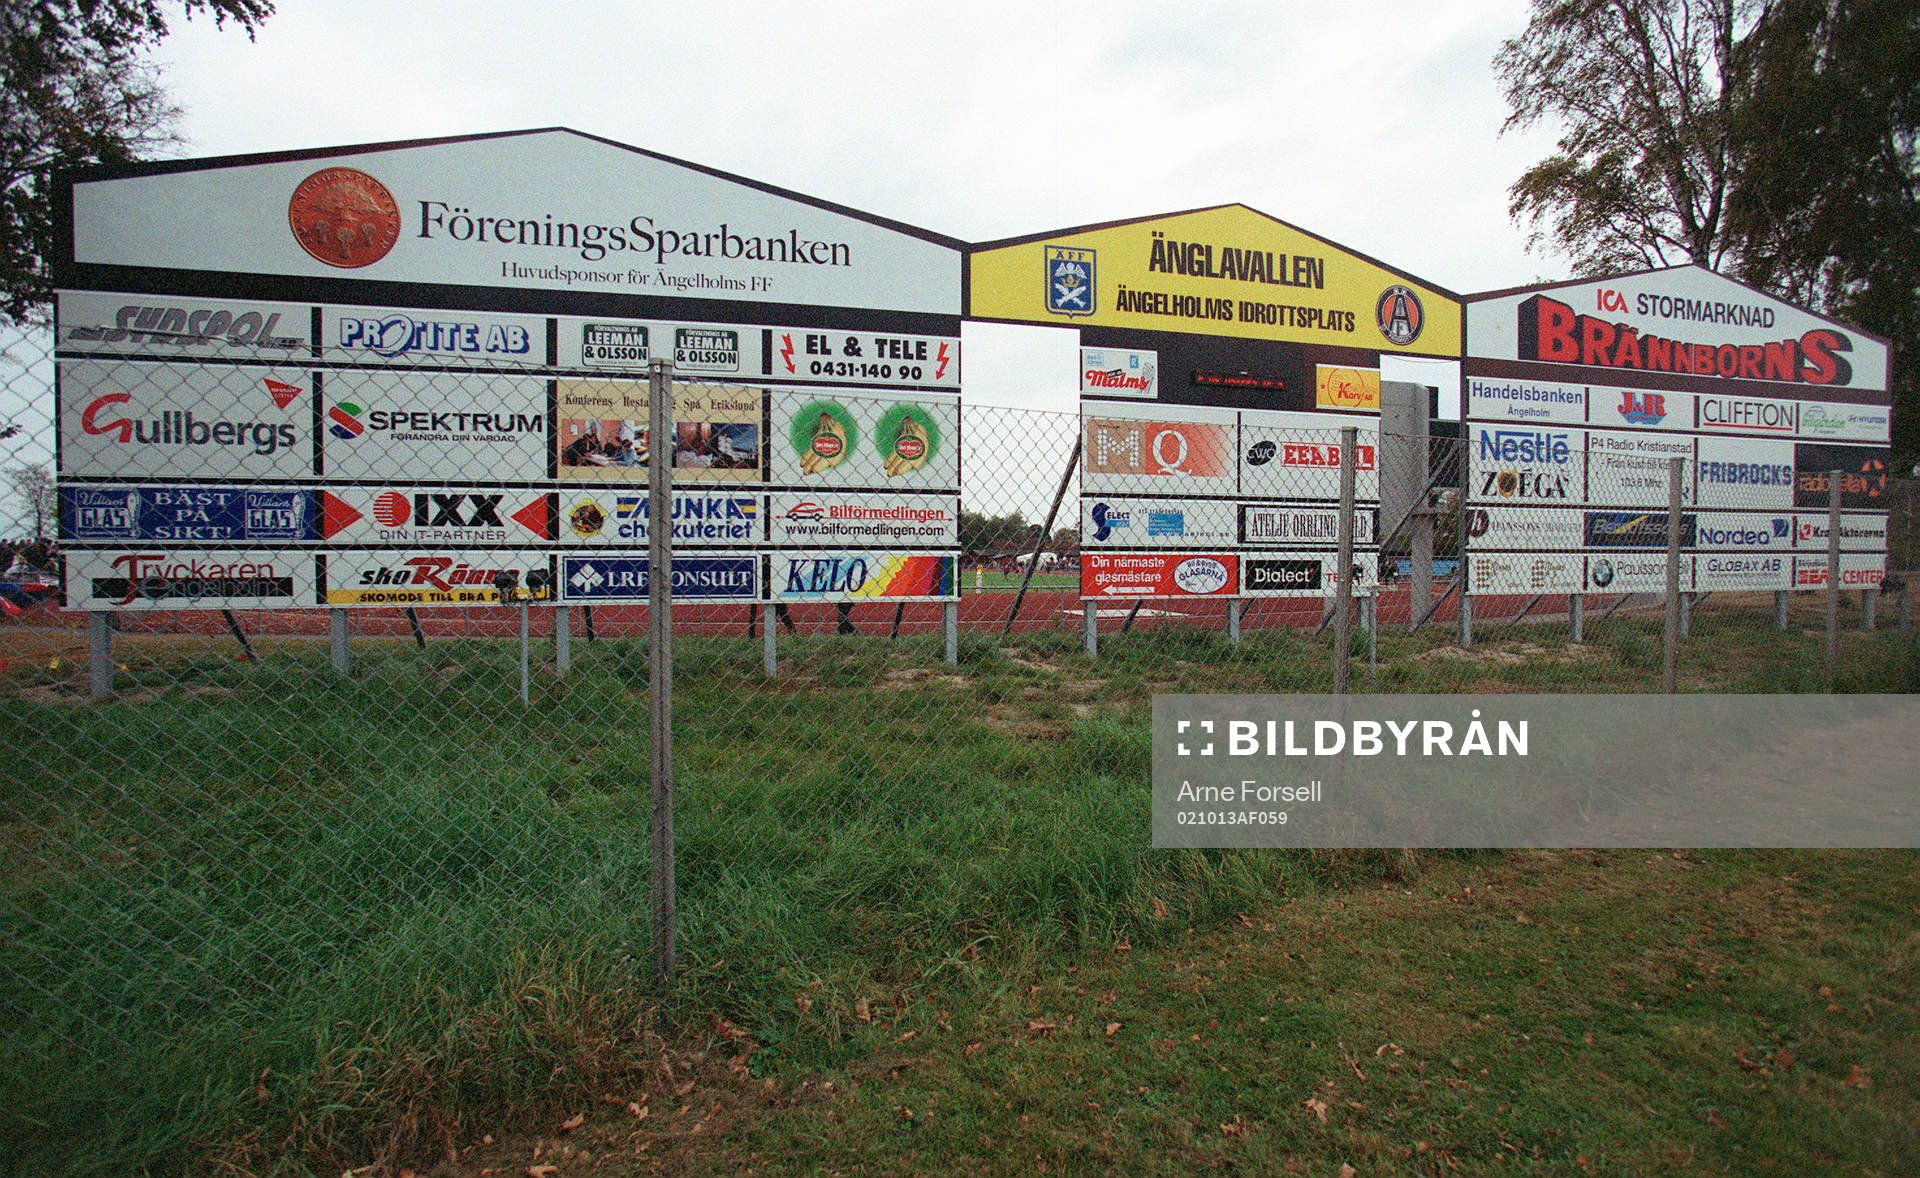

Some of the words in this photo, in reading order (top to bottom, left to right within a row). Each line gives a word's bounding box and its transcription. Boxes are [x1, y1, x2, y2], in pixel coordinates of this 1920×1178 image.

[417, 200, 852, 266] FöreningsSparbanken
[1056, 248, 1085, 261] ÄFF
[1149, 230, 1324, 290] ÄNGLAVALLEN
[502, 261, 624, 285] Huvudsponsor
[627, 268, 650, 285] för
[653, 269, 747, 291] Ängelholms
[751, 276, 774, 292] FF
[1116, 284, 1234, 322] ÄNGELHOLMS
[1239, 300, 1356, 333] IDROTTSPLATS
[1597, 288, 1630, 314] ICA
[1637, 293, 1776, 329] STORMARKNAD
[340, 313, 480, 358] PROTITE
[486, 324, 530, 354] AB
[587, 331, 644, 346] LEEMAN
[679, 336, 733, 350] LEEMAN
[1521, 293, 1852, 386] BRÄNNBORNS
[585, 346, 595, 359] &
[598, 346, 648, 360] OLSSON
[806, 334, 832, 356] EL
[843, 336, 864, 357] &
[875, 338, 928, 361] TELE
[676, 350, 687, 363] &
[689, 351, 737, 364] OLSSON
[899, 366, 922, 380] 90
[1085, 369, 1150, 391] Malms
[1473, 382, 1583, 404] Handelsbanken
[566, 394, 613, 407] Konferens
[684, 398, 702, 412] Spa
[710, 399, 755, 412] Erikslund
[1508, 403, 1550, 418] Ängelholm
[368, 410, 543, 434] SPEKTRUM
[1703, 399, 1794, 427] CLIFFTON
[82, 392, 296, 456] Gullbergs
[391, 432, 448, 442] FÖRÄNDRA
[452, 433, 470, 443] DIN
[1480, 429, 1569, 464] Nestlé
[1591, 437, 1604, 449] P4
[1607, 438, 1635, 451] Radio
[1637, 440, 1692, 454] Kristianstad
[1699, 462, 1792, 486] FRIBROCKS
[155, 489, 232, 506] BÄST
[80, 508, 128, 529] GLAS
[176, 505, 210, 522] PÅ
[249, 509, 293, 529] GLAS
[414, 493, 505, 527] IXX
[829, 505, 945, 523] Bilförmedlingen
[155, 526, 232, 539] SIKT!
[380, 529, 408, 541] DIN
[414, 530, 507, 541] IT-PARTNER
[1699, 526, 1770, 545] Nordea
[1091, 555, 1110, 568] Din
[1114, 556, 1165, 568] närmaste
[1707, 558, 1759, 572] GLOBAX
[1761, 558, 1781, 572] AB
[110, 555, 275, 606] Tryckaren
[784, 558, 868, 593] KELO
[1095, 571, 1162, 586] glasmästare
[1179, 567, 1224, 582] GLASARNA
[1254, 568, 1311, 583] Dialect
[360, 593, 424, 603] SKOMODE
[429, 593, 453, 602] TILL
[459, 593, 485, 602] BRA
